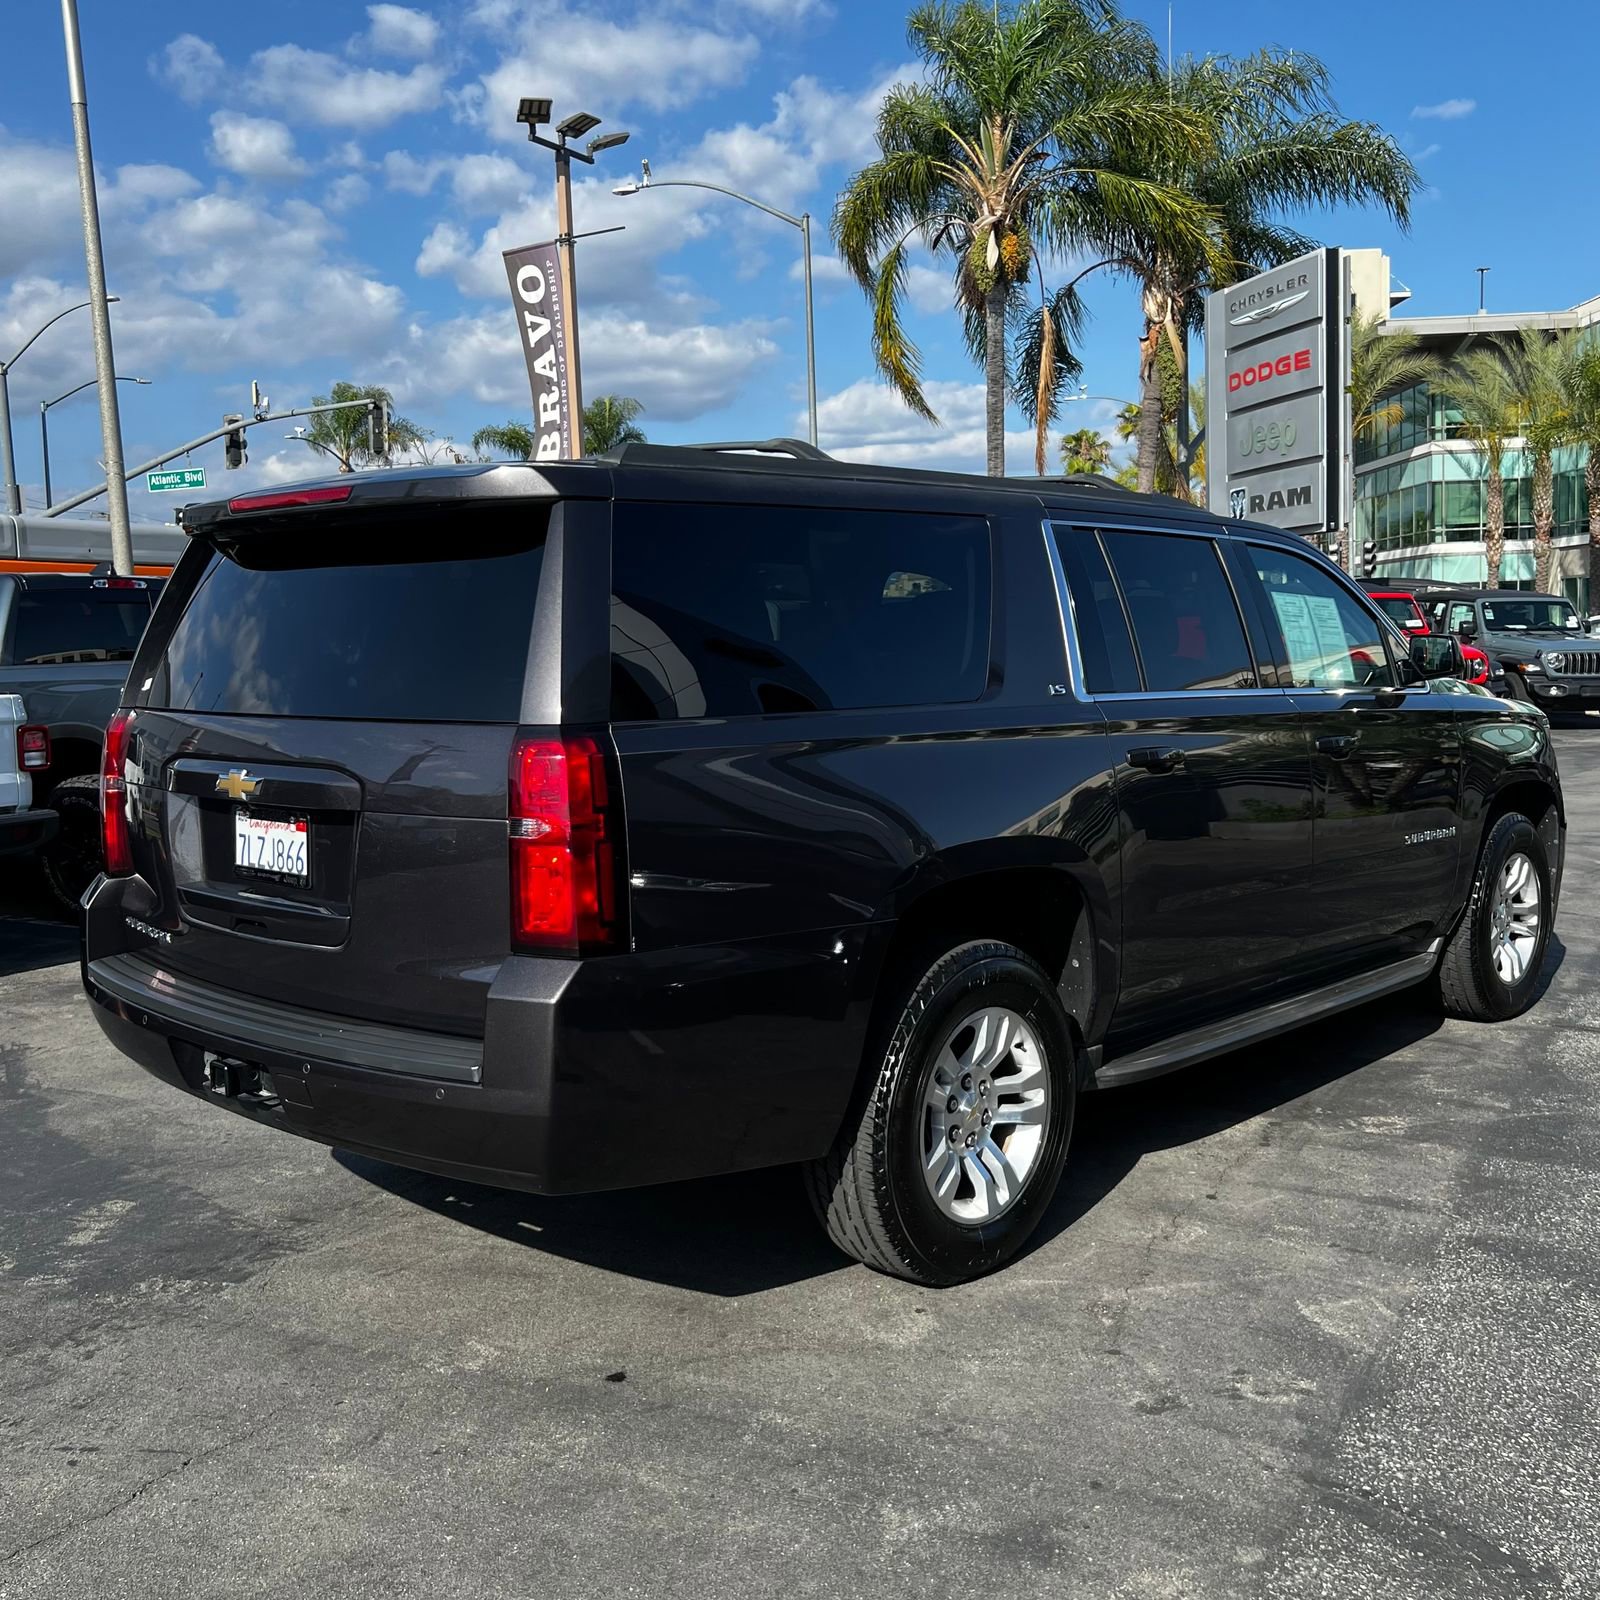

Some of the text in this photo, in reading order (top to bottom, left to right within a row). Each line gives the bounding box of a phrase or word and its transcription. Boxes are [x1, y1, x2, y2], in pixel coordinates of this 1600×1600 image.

[546, 260, 564, 348] DEALERSHIP
[1230, 274, 1309, 314] CHRYSLER
[517, 264, 561, 461] BRAVO
[1229, 349, 1311, 392] DODGE
[1240, 416, 1297, 457] Jeep
[151, 471, 203, 485] Atlantic Blvd
[1250, 485, 1312, 514] RAM
[238, 833, 305, 874] 7LZJ866
